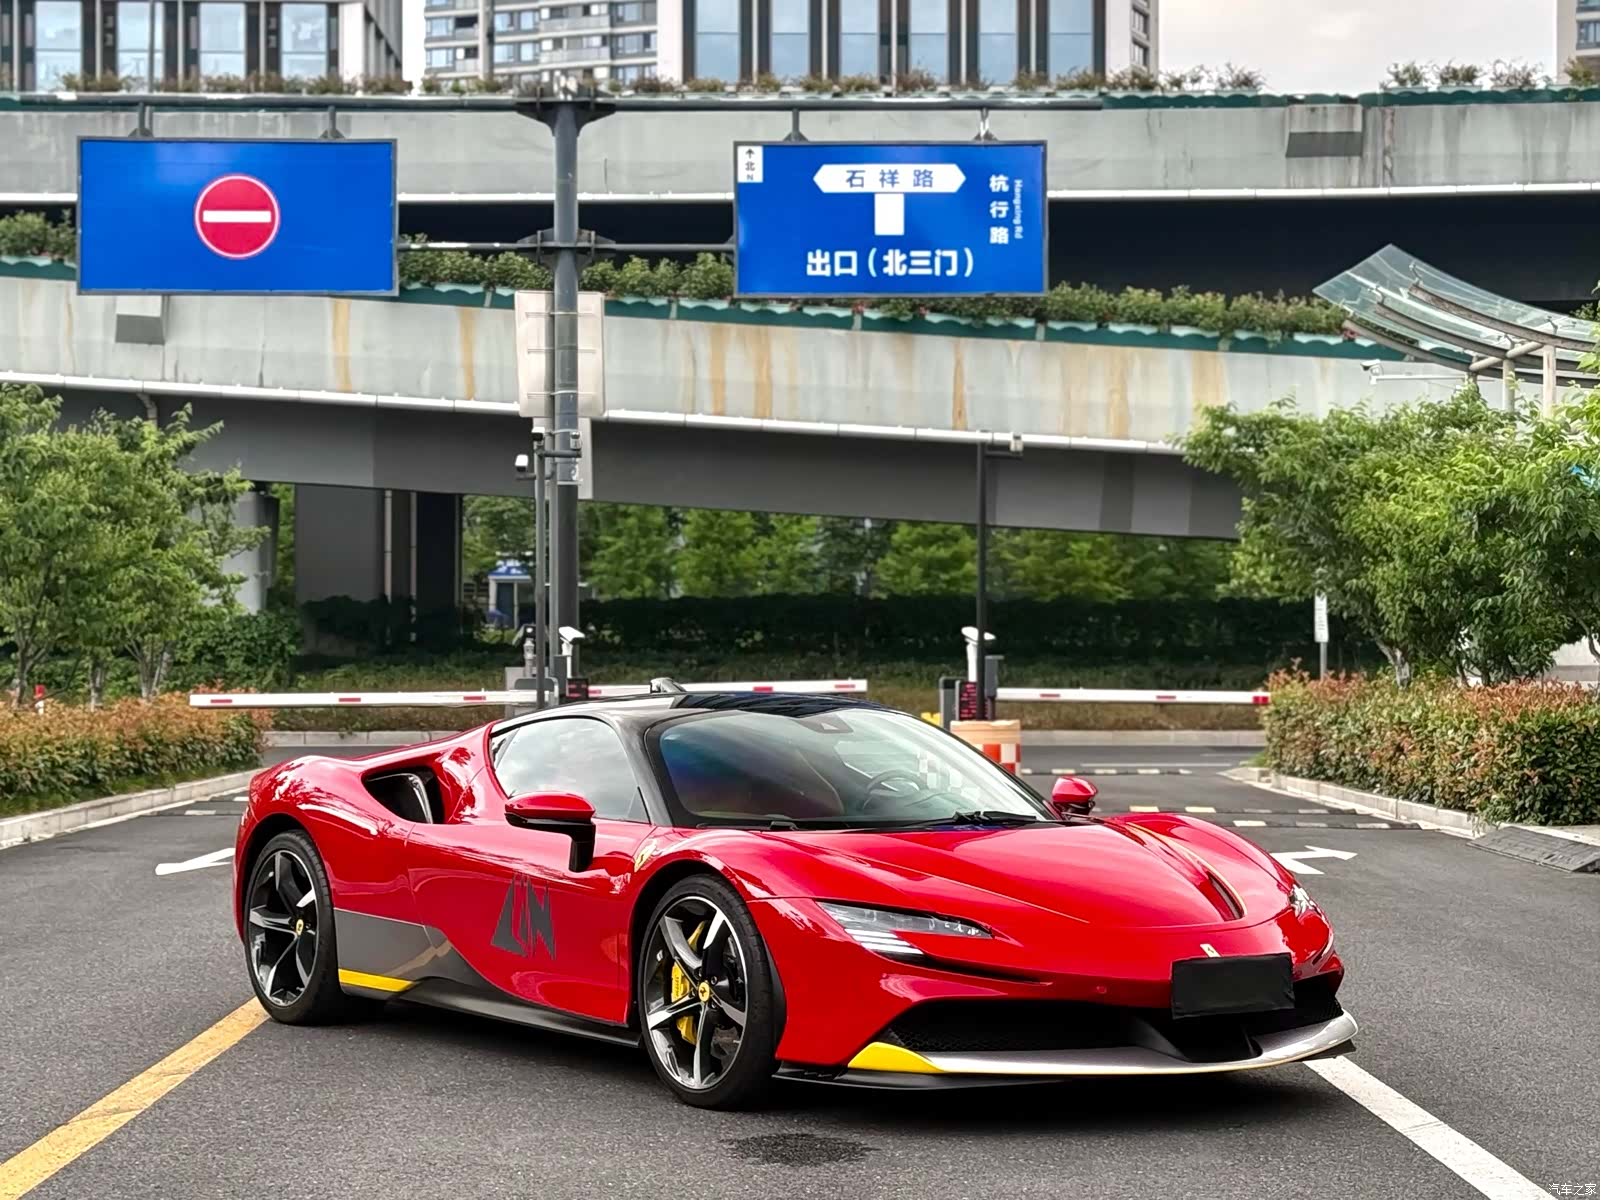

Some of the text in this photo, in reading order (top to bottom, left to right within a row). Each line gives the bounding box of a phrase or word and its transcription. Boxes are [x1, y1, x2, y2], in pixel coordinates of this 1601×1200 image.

[745, 161, 755, 171] 北
[845, 169, 934, 188] 石祥路
[989, 174, 1009, 244] 杭行路
[1014, 225, 1024, 239] Rd
